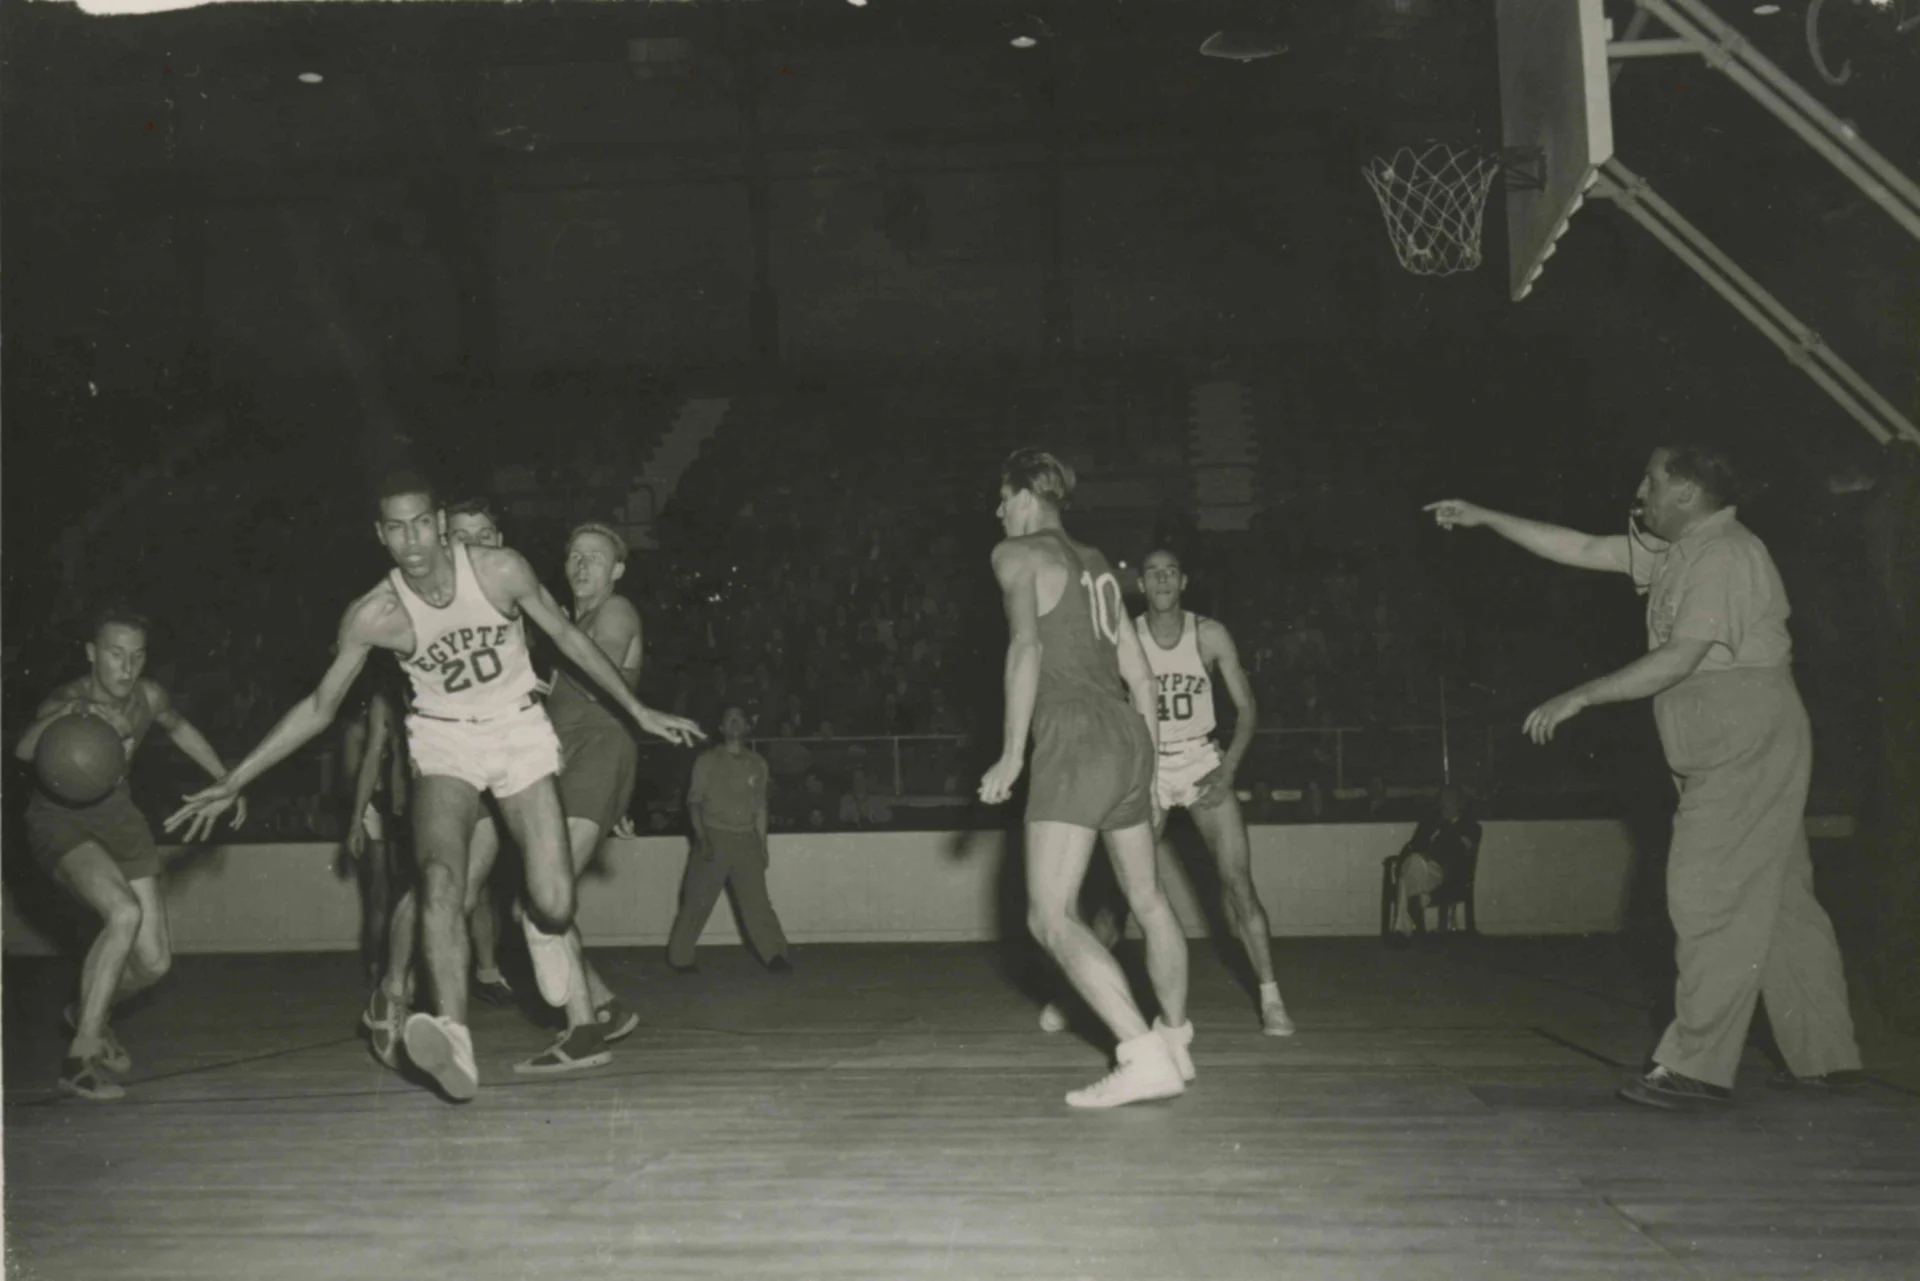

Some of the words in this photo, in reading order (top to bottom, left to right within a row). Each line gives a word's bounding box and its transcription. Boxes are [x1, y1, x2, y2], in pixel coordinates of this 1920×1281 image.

[1080, 571, 1121, 645] 10
[412, 625, 508, 672] EGYPTE
[441, 647, 502, 694] 20
[1156, 693, 1193, 721] 40
